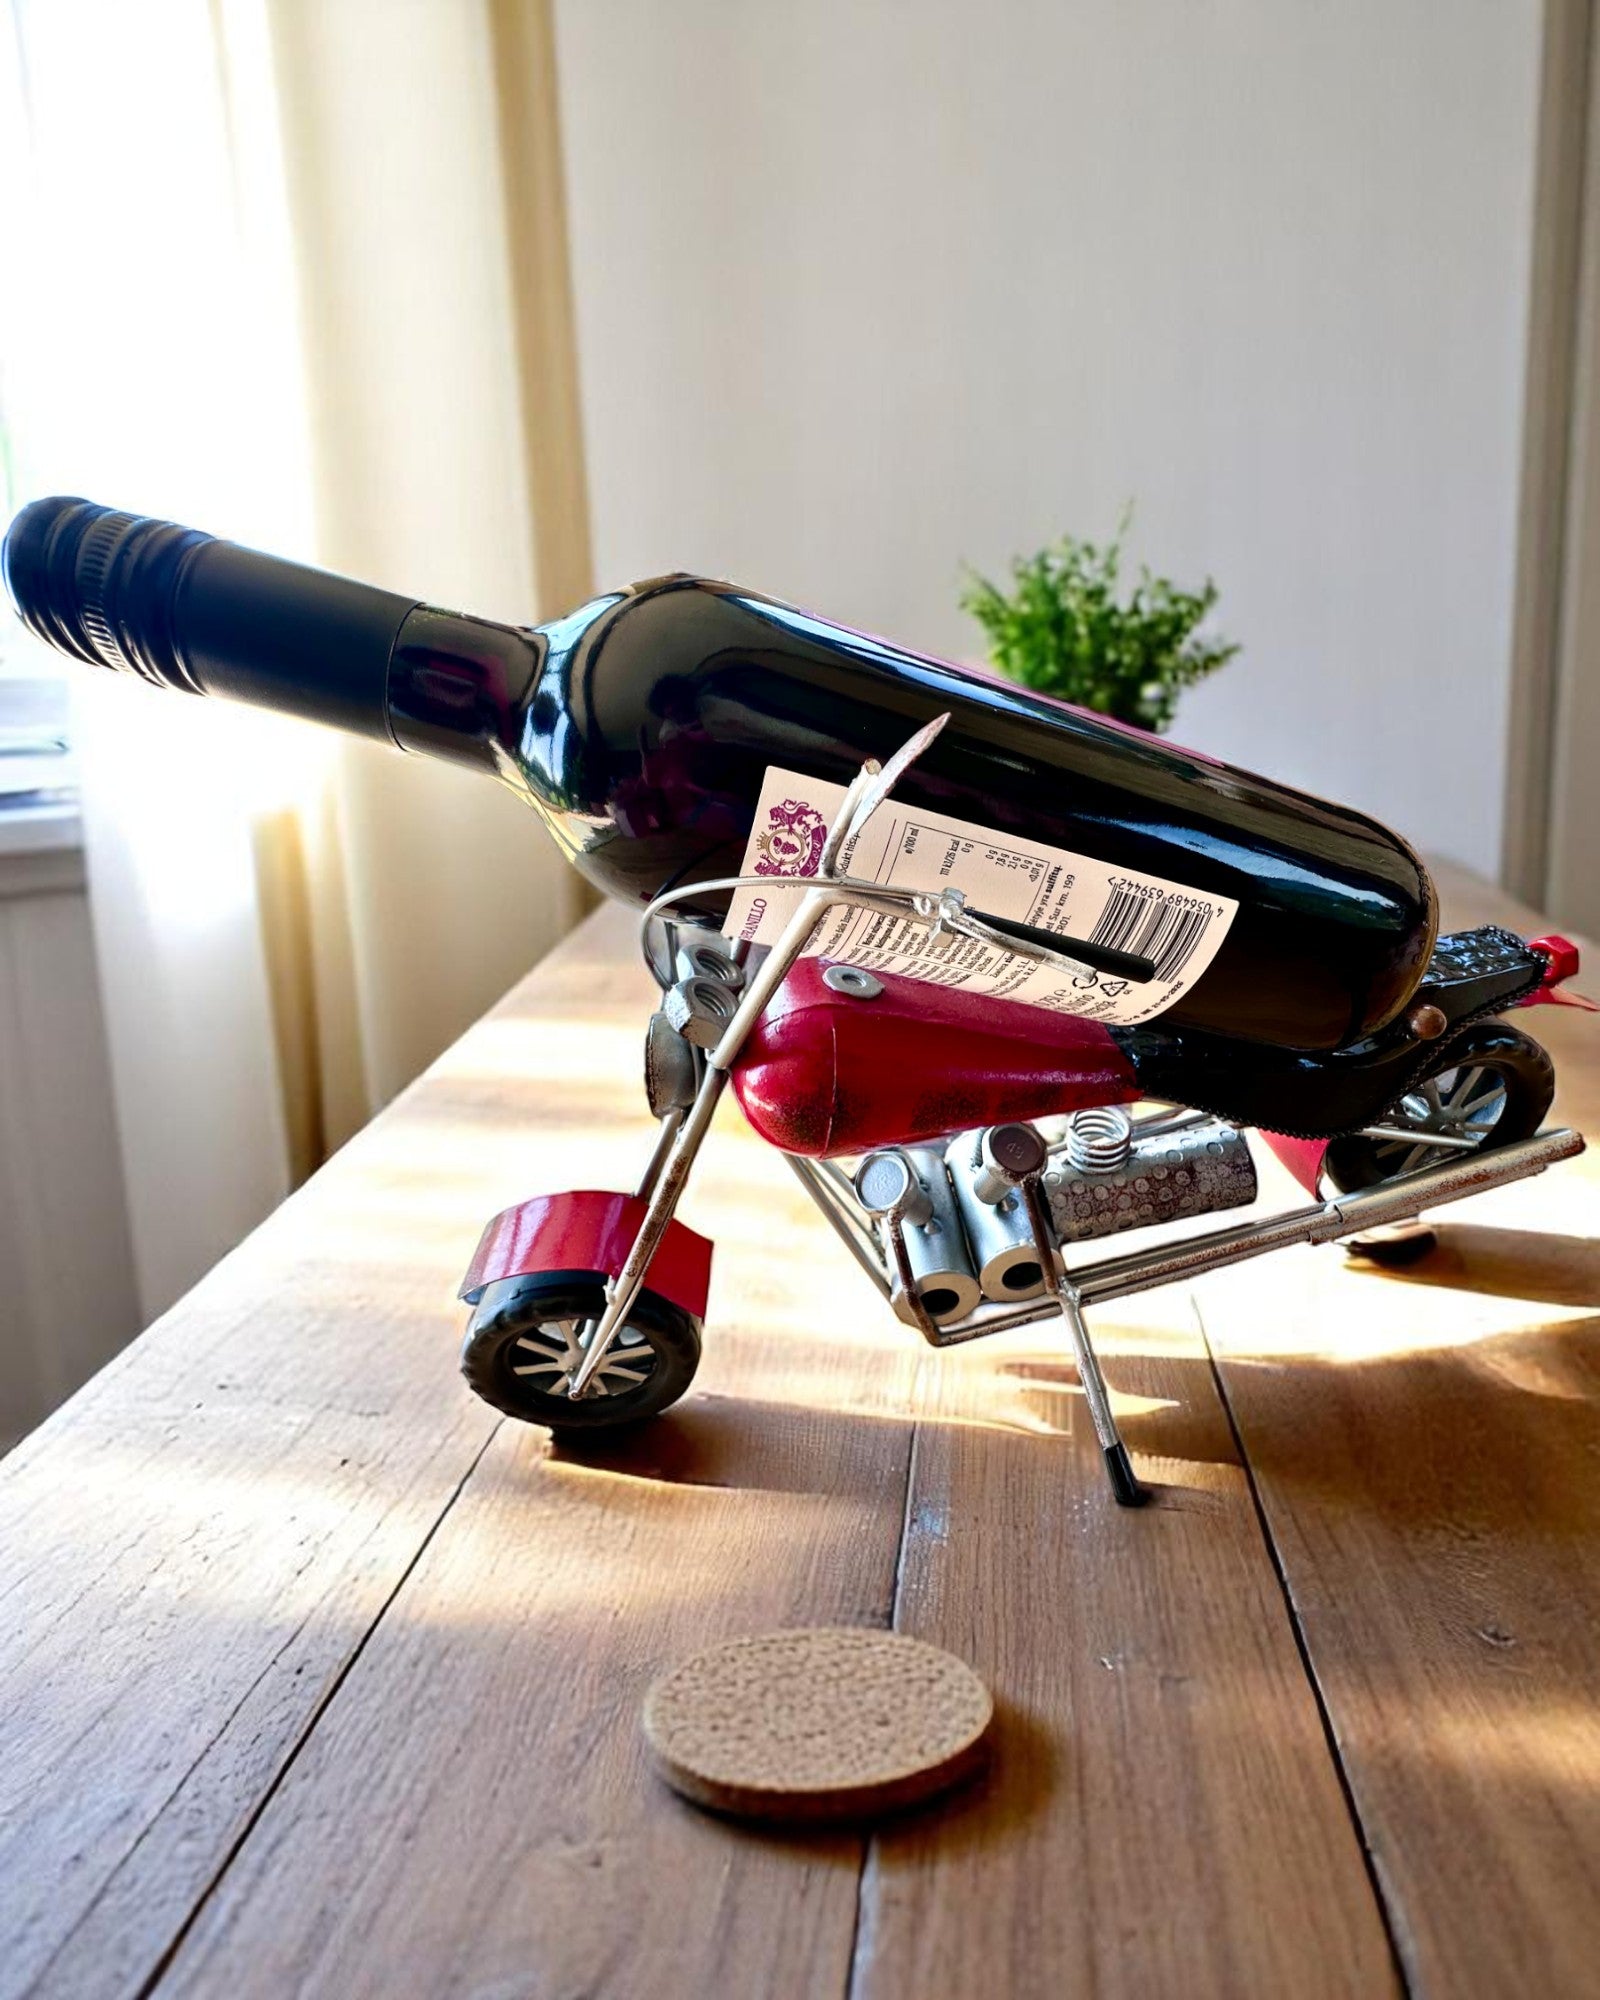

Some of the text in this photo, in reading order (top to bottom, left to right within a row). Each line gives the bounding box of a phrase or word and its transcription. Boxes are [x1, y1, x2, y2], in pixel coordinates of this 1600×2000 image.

[839, 830, 861, 874] odukt hiszp
[950, 839, 961, 853] kcal
[1063, 874, 1075, 889] 199
[1118, 878, 1164, 901] 639442
[1055, 892, 1070, 907] km.
[1167, 893, 1212, 915] 056489
[1028, 906, 1044, 928] dėtyje
[1040, 894, 1050, 907] yra
[1049, 907, 1062, 921] Sur
[1217, 906, 1224, 918] 4
